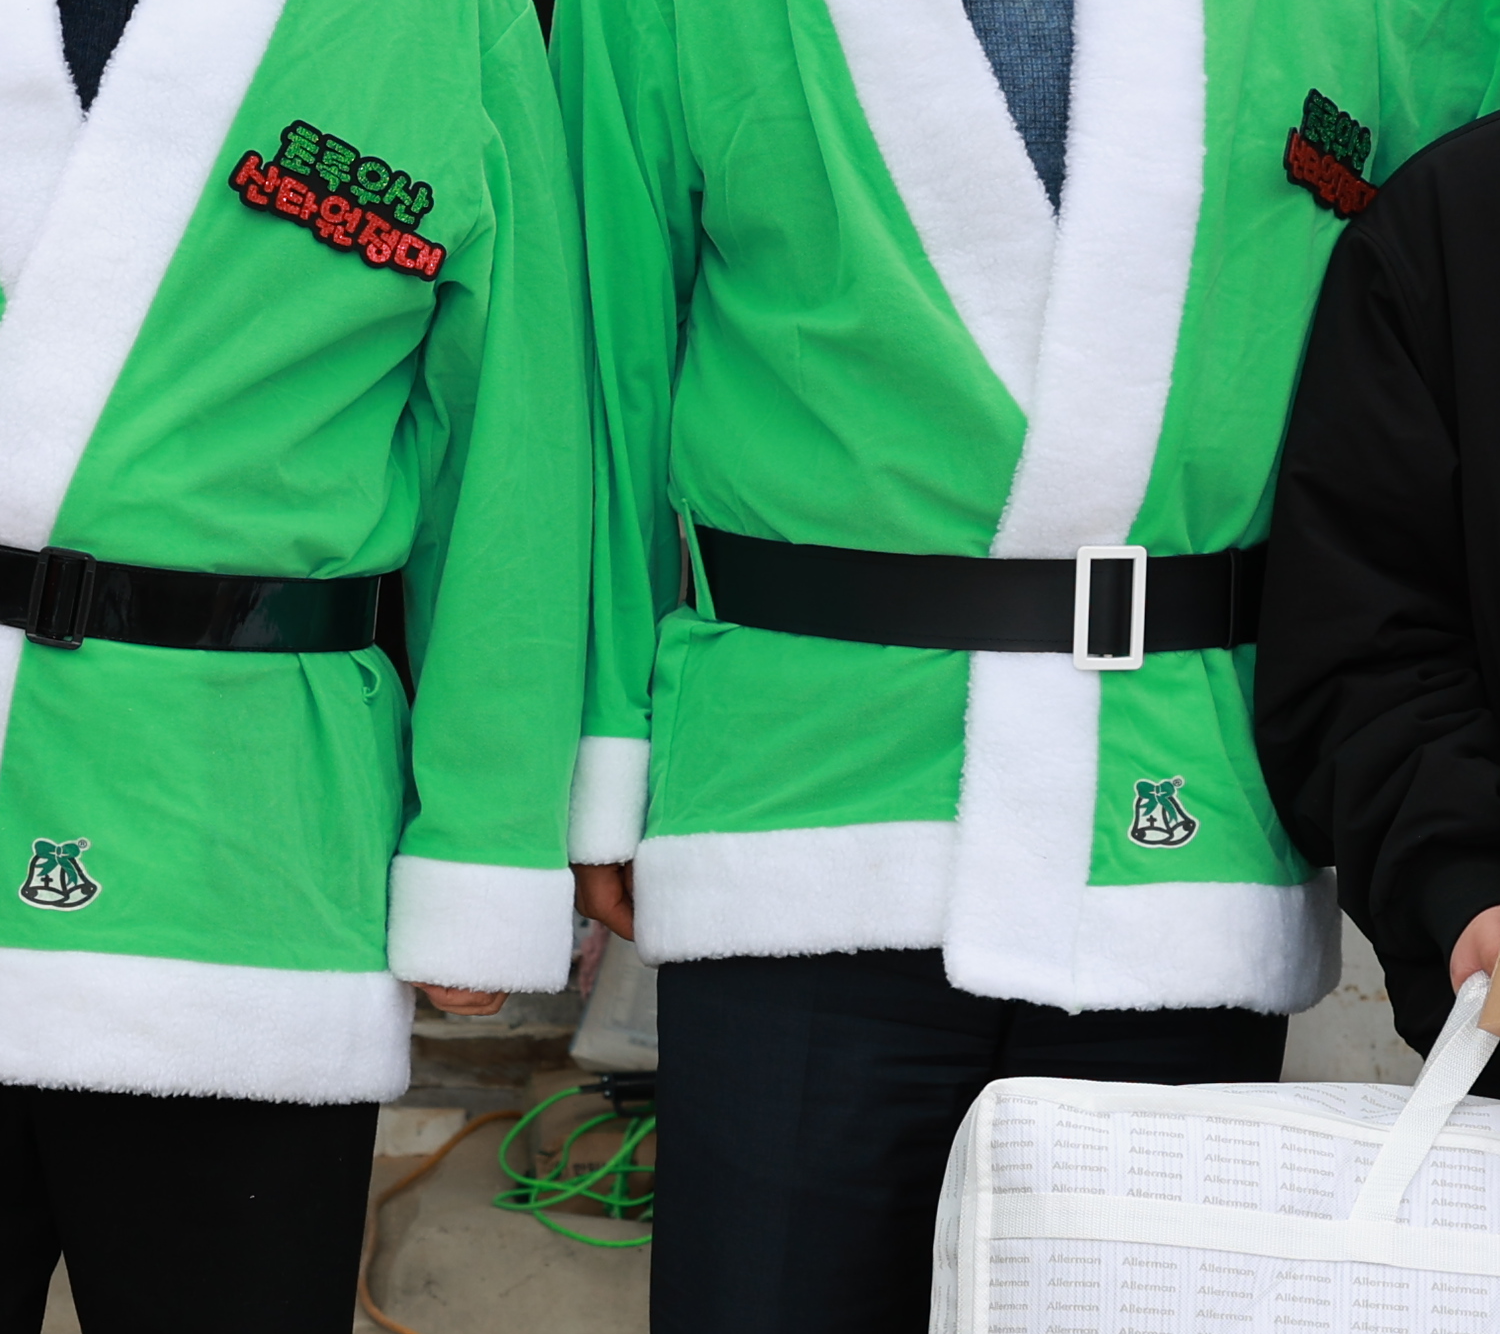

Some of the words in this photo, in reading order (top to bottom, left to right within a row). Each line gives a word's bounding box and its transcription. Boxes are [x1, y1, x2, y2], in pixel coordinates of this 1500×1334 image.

[280, 125, 430, 226] 초록우산
[234, 154, 443, 277] 산타원정대
[1050, 1182, 1107, 1196] Allerman
[1275, 1203, 1335, 1221] Allerman
[1431, 1217, 1488, 1232] Allerman
[1046, 1301, 1101, 1313] Allerman
[1430, 1304, 1489, 1320] Allerman
